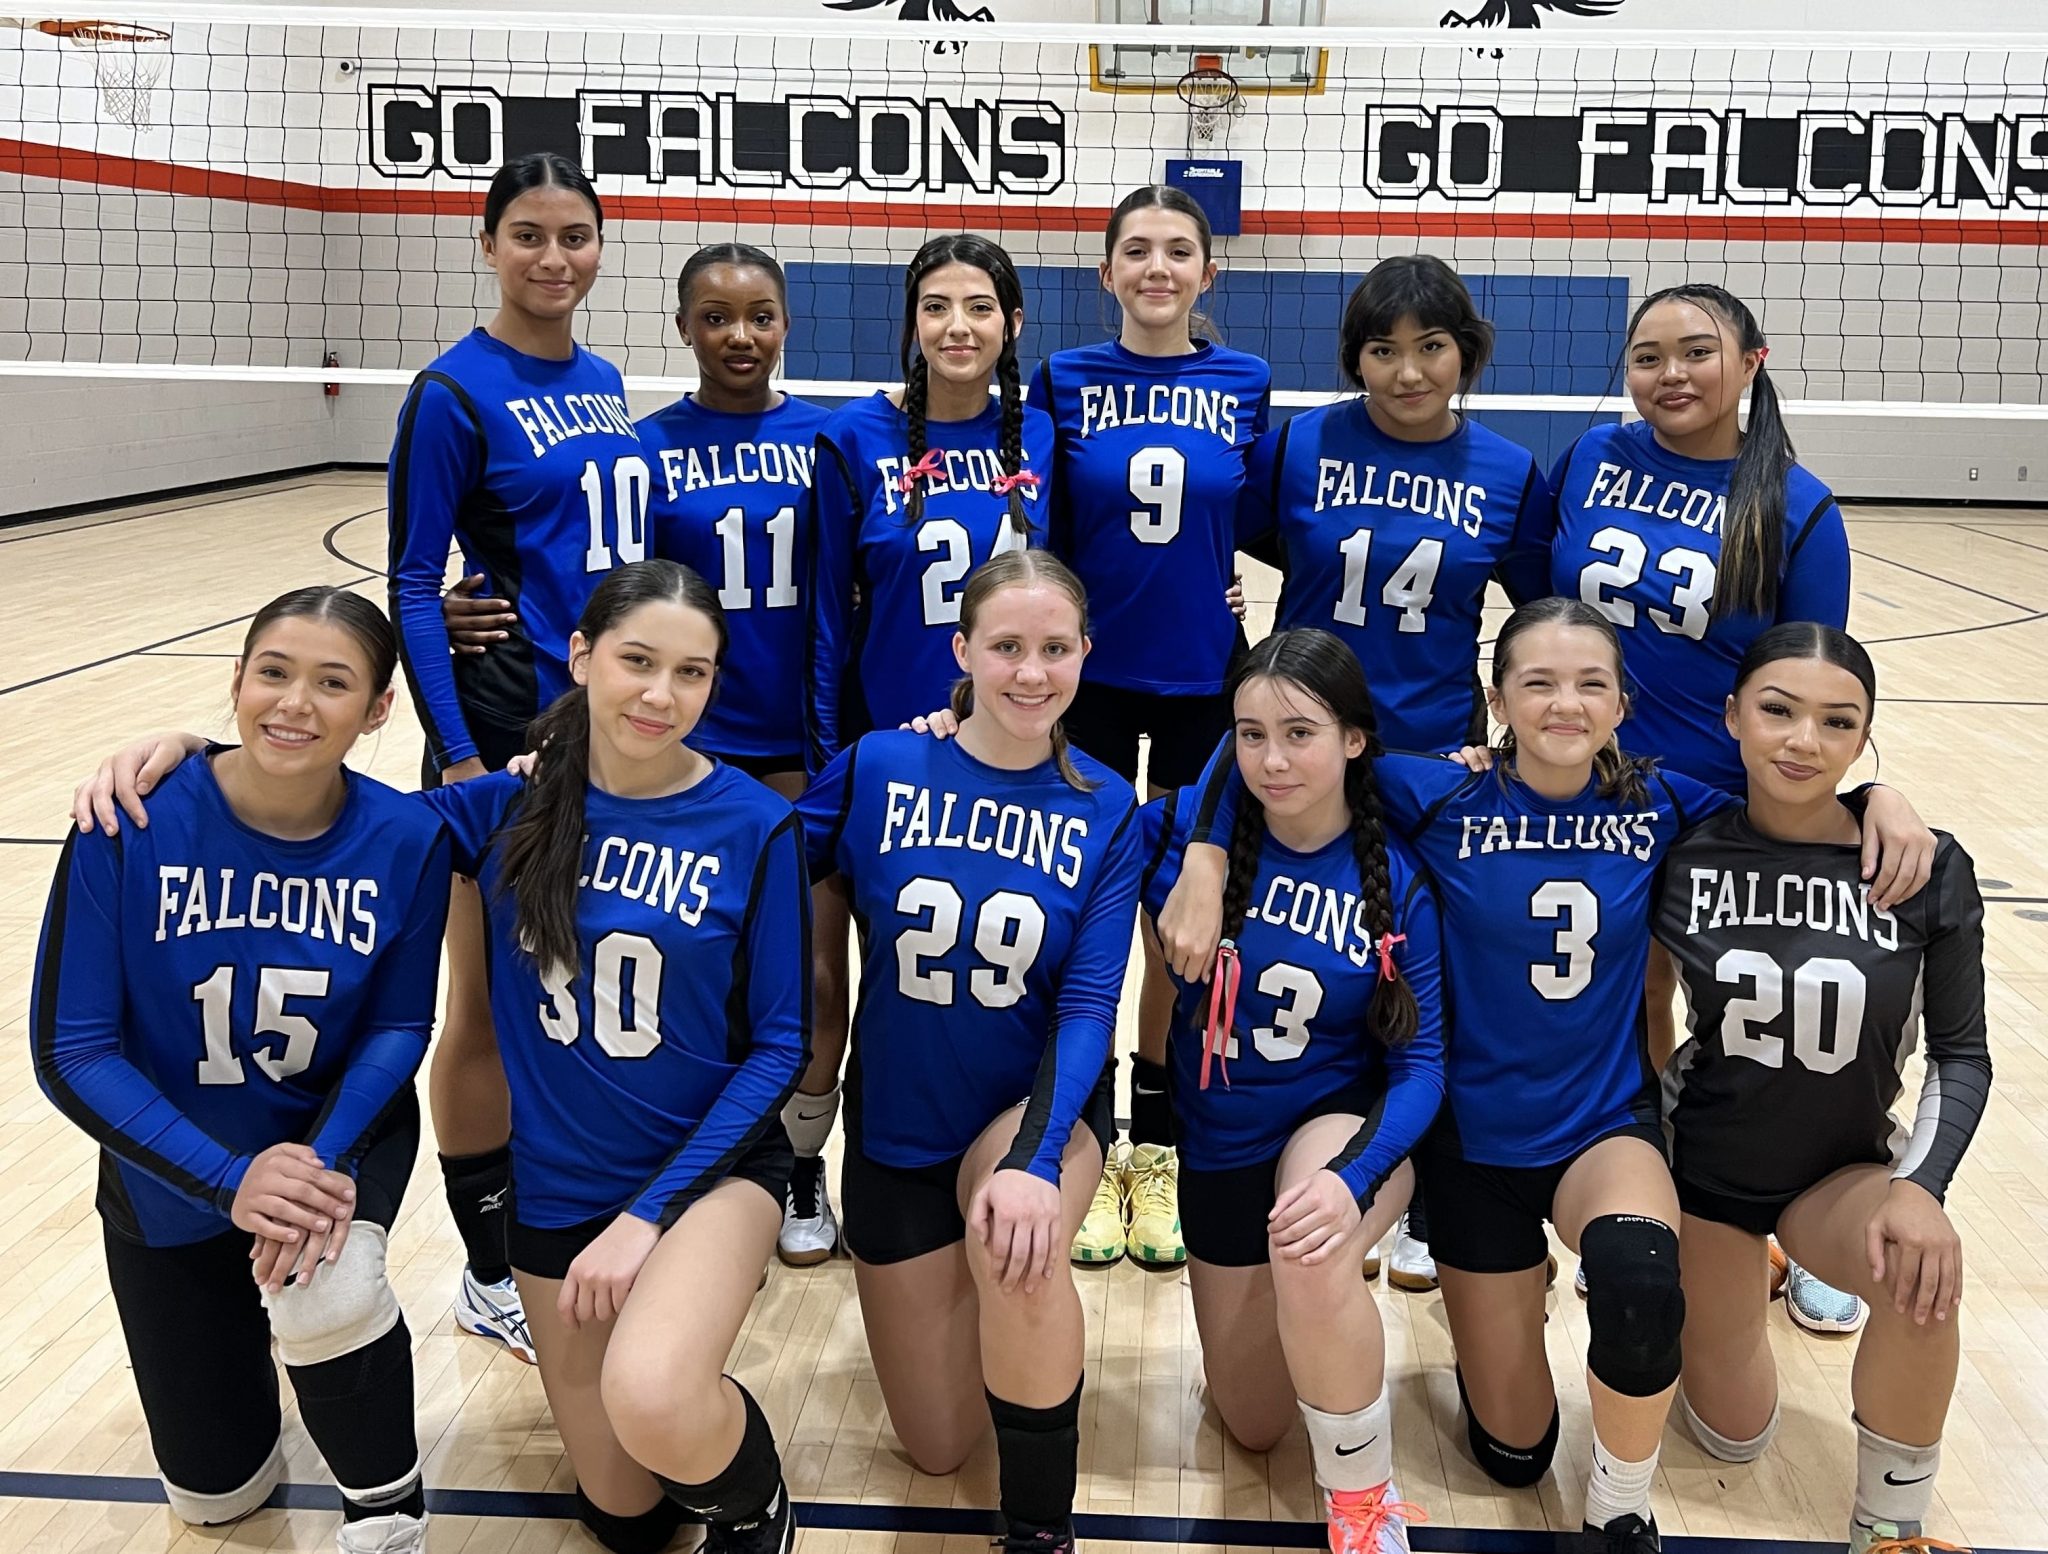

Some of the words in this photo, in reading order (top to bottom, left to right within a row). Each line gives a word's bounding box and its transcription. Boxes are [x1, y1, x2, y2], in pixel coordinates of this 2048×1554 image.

[367, 83, 505, 179] GO
[576, 88, 1065, 195] FALCONS
[1363, 103, 1505, 201] GO
[1079, 384, 1240, 446] FALCONS
[579, 455, 650, 573] 10
[658, 441, 816, 503] FALCON
[1129, 446, 1186, 545] 9
[1313, 458, 1487, 540] FALCONS
[1582, 460, 1727, 540] FALCON
[715, 506, 798, 610] 11
[1332, 527, 1444, 634] 14
[1579, 526, 1718, 641] 23
[509, 834, 721, 928] CONS
[879, 781, 1089, 889] FALCONS
[154, 864, 379, 957] FALCONS
[895, 876, 1046, 1009] 29
[1245, 874, 1373, 968] CONS
[1529, 880, 1599, 1001] 3
[1685, 867, 1900, 953] FALCONS
[193, 965, 330, 1085] 15
[1201, 961, 1325, 1063] 3
[1715, 948, 1867, 1076] 20
